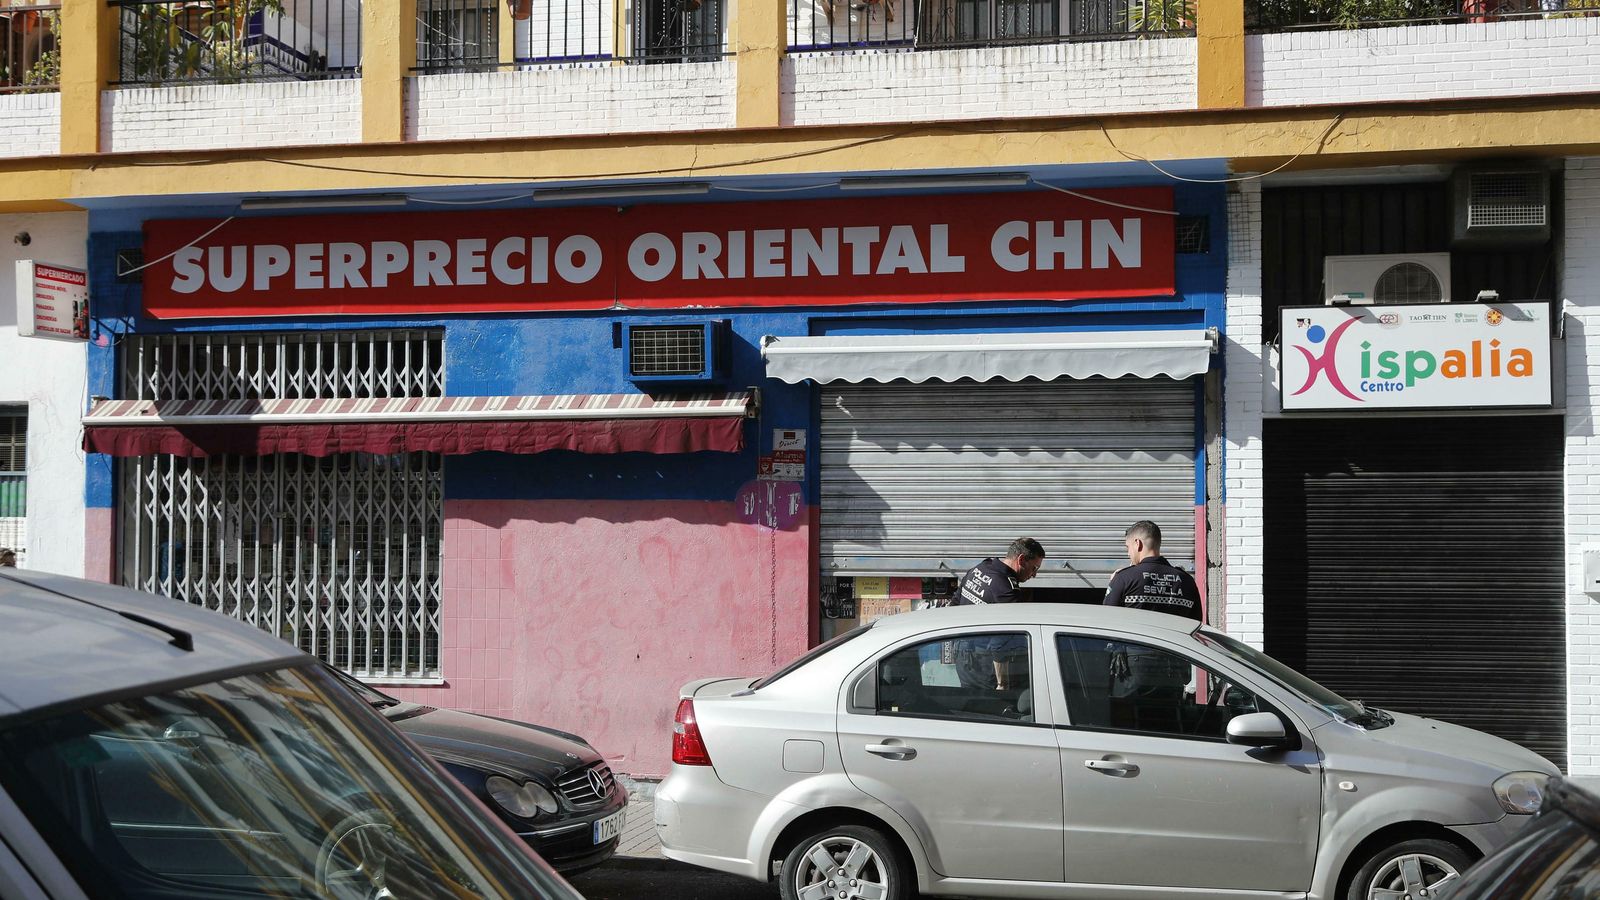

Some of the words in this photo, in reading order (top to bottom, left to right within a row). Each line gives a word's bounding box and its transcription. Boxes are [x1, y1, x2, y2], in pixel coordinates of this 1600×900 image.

[171, 235, 603, 294] SUPERPRECIO
[627, 223, 966, 282] ORIENTAL
[991, 218, 1142, 271] CHN
[37, 266, 84, 284] SUPERMERCADO
[1360, 380, 1404, 392] Centro
[972, 567, 993, 586] POLICIA
[1142, 571, 1182, 583] POLICIA
[965, 579, 985, 598] SEVILLA
[1143, 584, 1184, 597] SEVILLA
[601, 816, 618, 839] 1762
